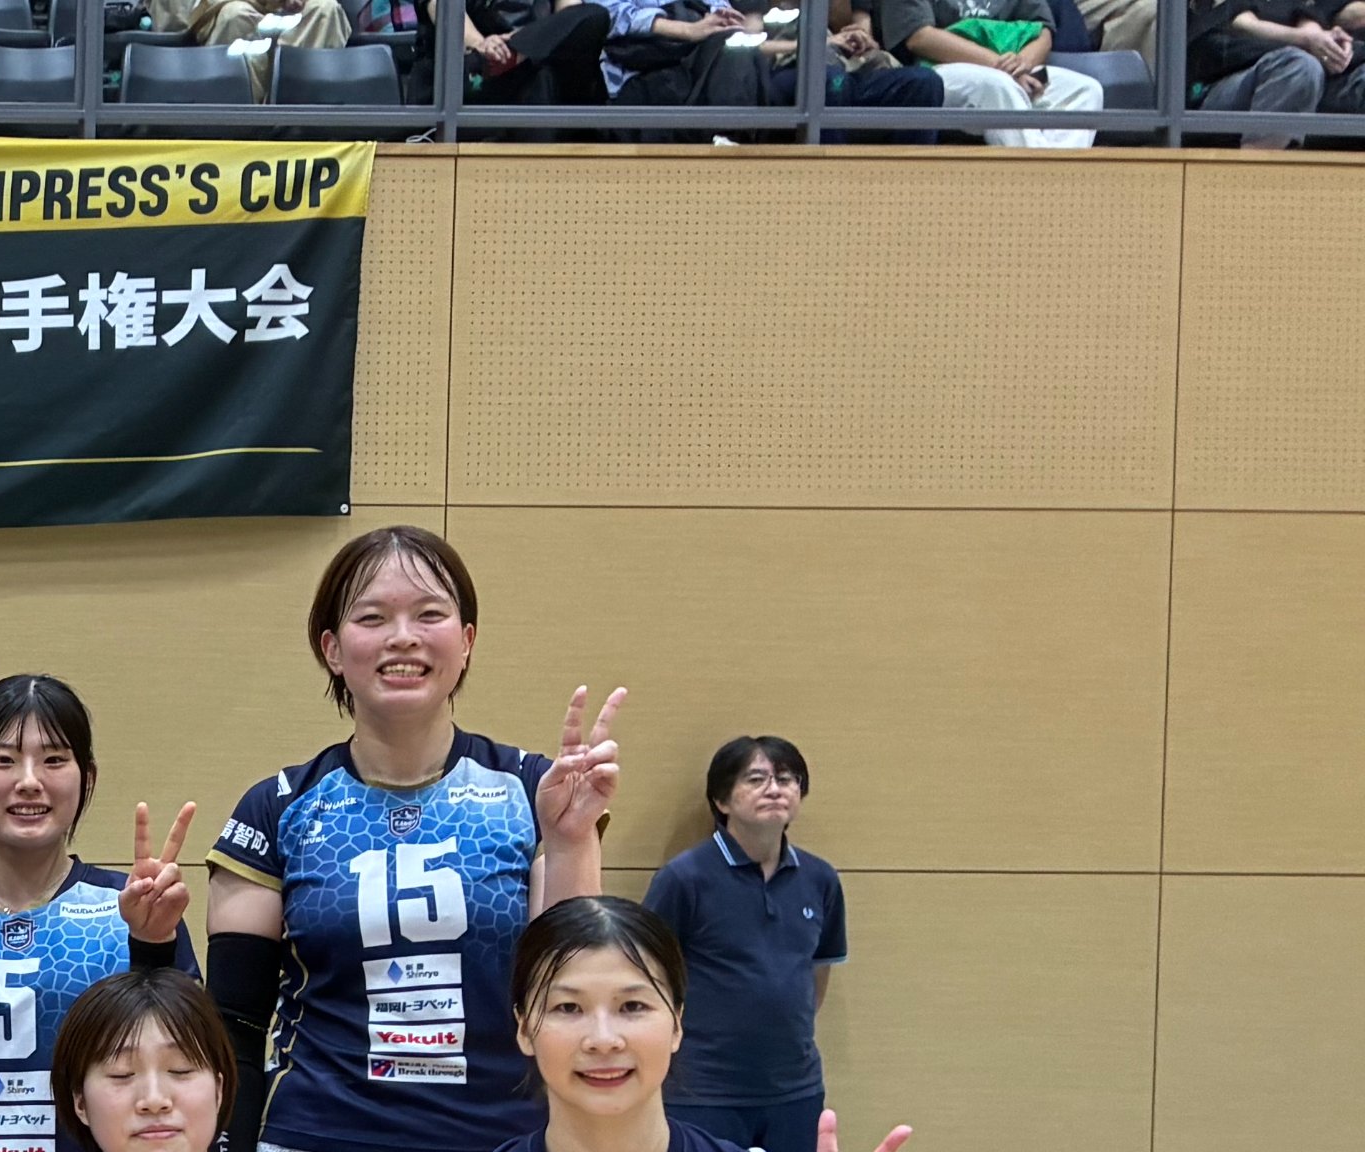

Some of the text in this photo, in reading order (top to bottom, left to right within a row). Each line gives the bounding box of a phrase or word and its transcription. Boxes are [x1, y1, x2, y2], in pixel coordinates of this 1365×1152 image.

[239, 157, 341, 213] CUP
[349, 836, 467, 948] 15
[376, 1030, 459, 1045] Yakult
[430, 1069, 466, 1079] through
